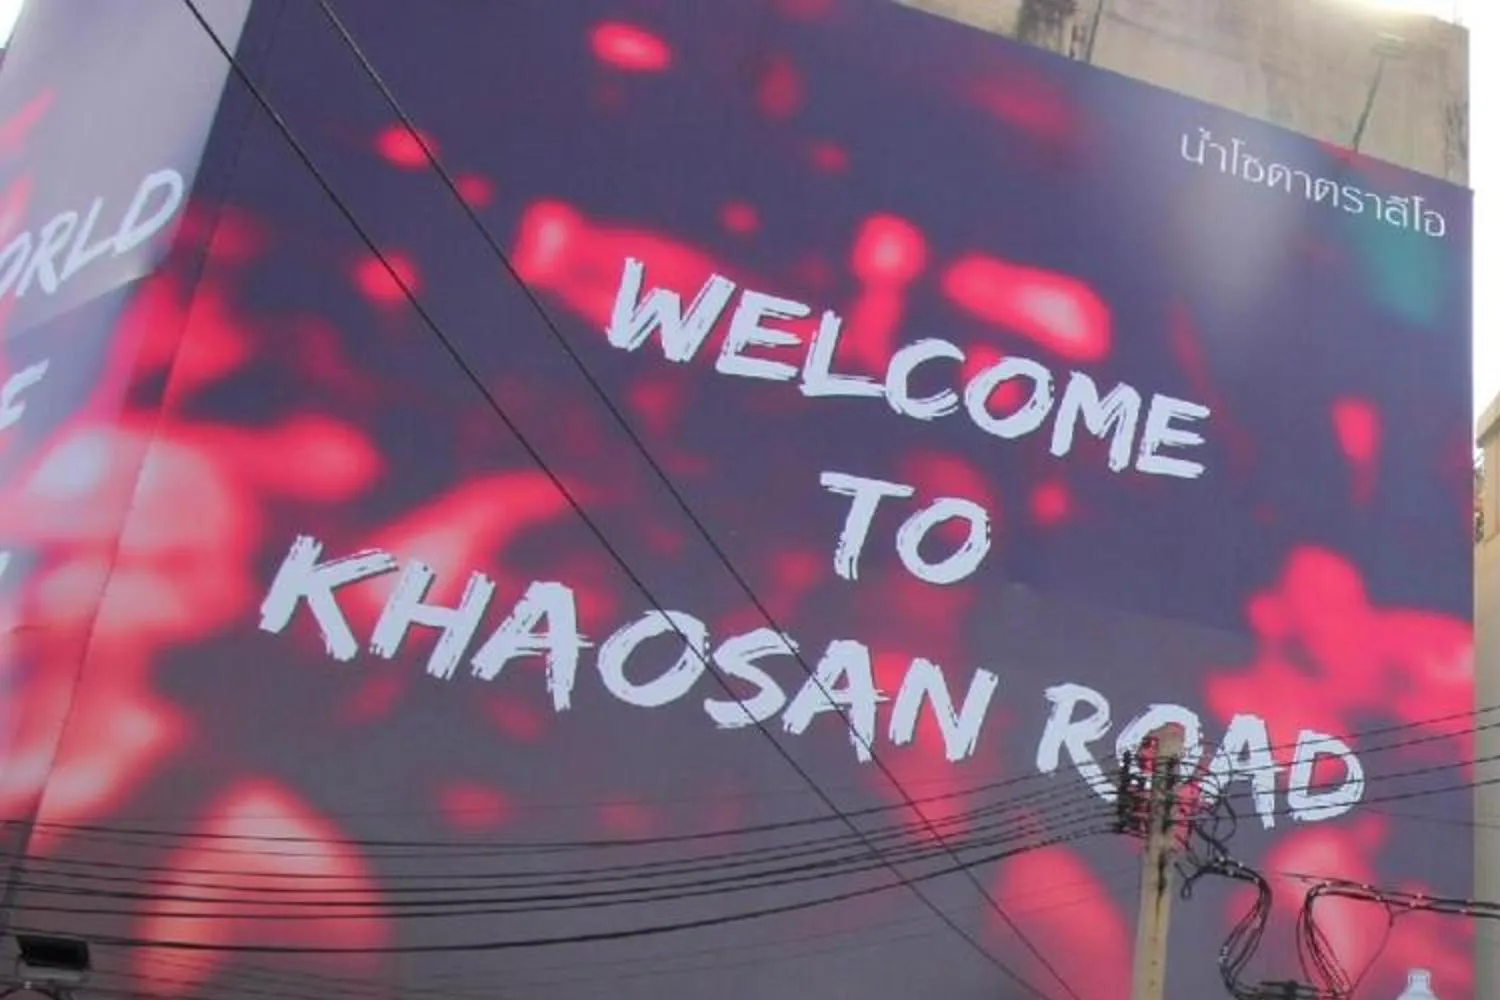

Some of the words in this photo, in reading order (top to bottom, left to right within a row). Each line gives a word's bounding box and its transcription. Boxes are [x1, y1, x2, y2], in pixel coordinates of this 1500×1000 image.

[607, 257, 1211, 480] WELCOME
[820, 471, 992, 585] TO
[260, 535, 998, 763] KHAOSAN
[1036, 683, 1366, 830] ROAD
